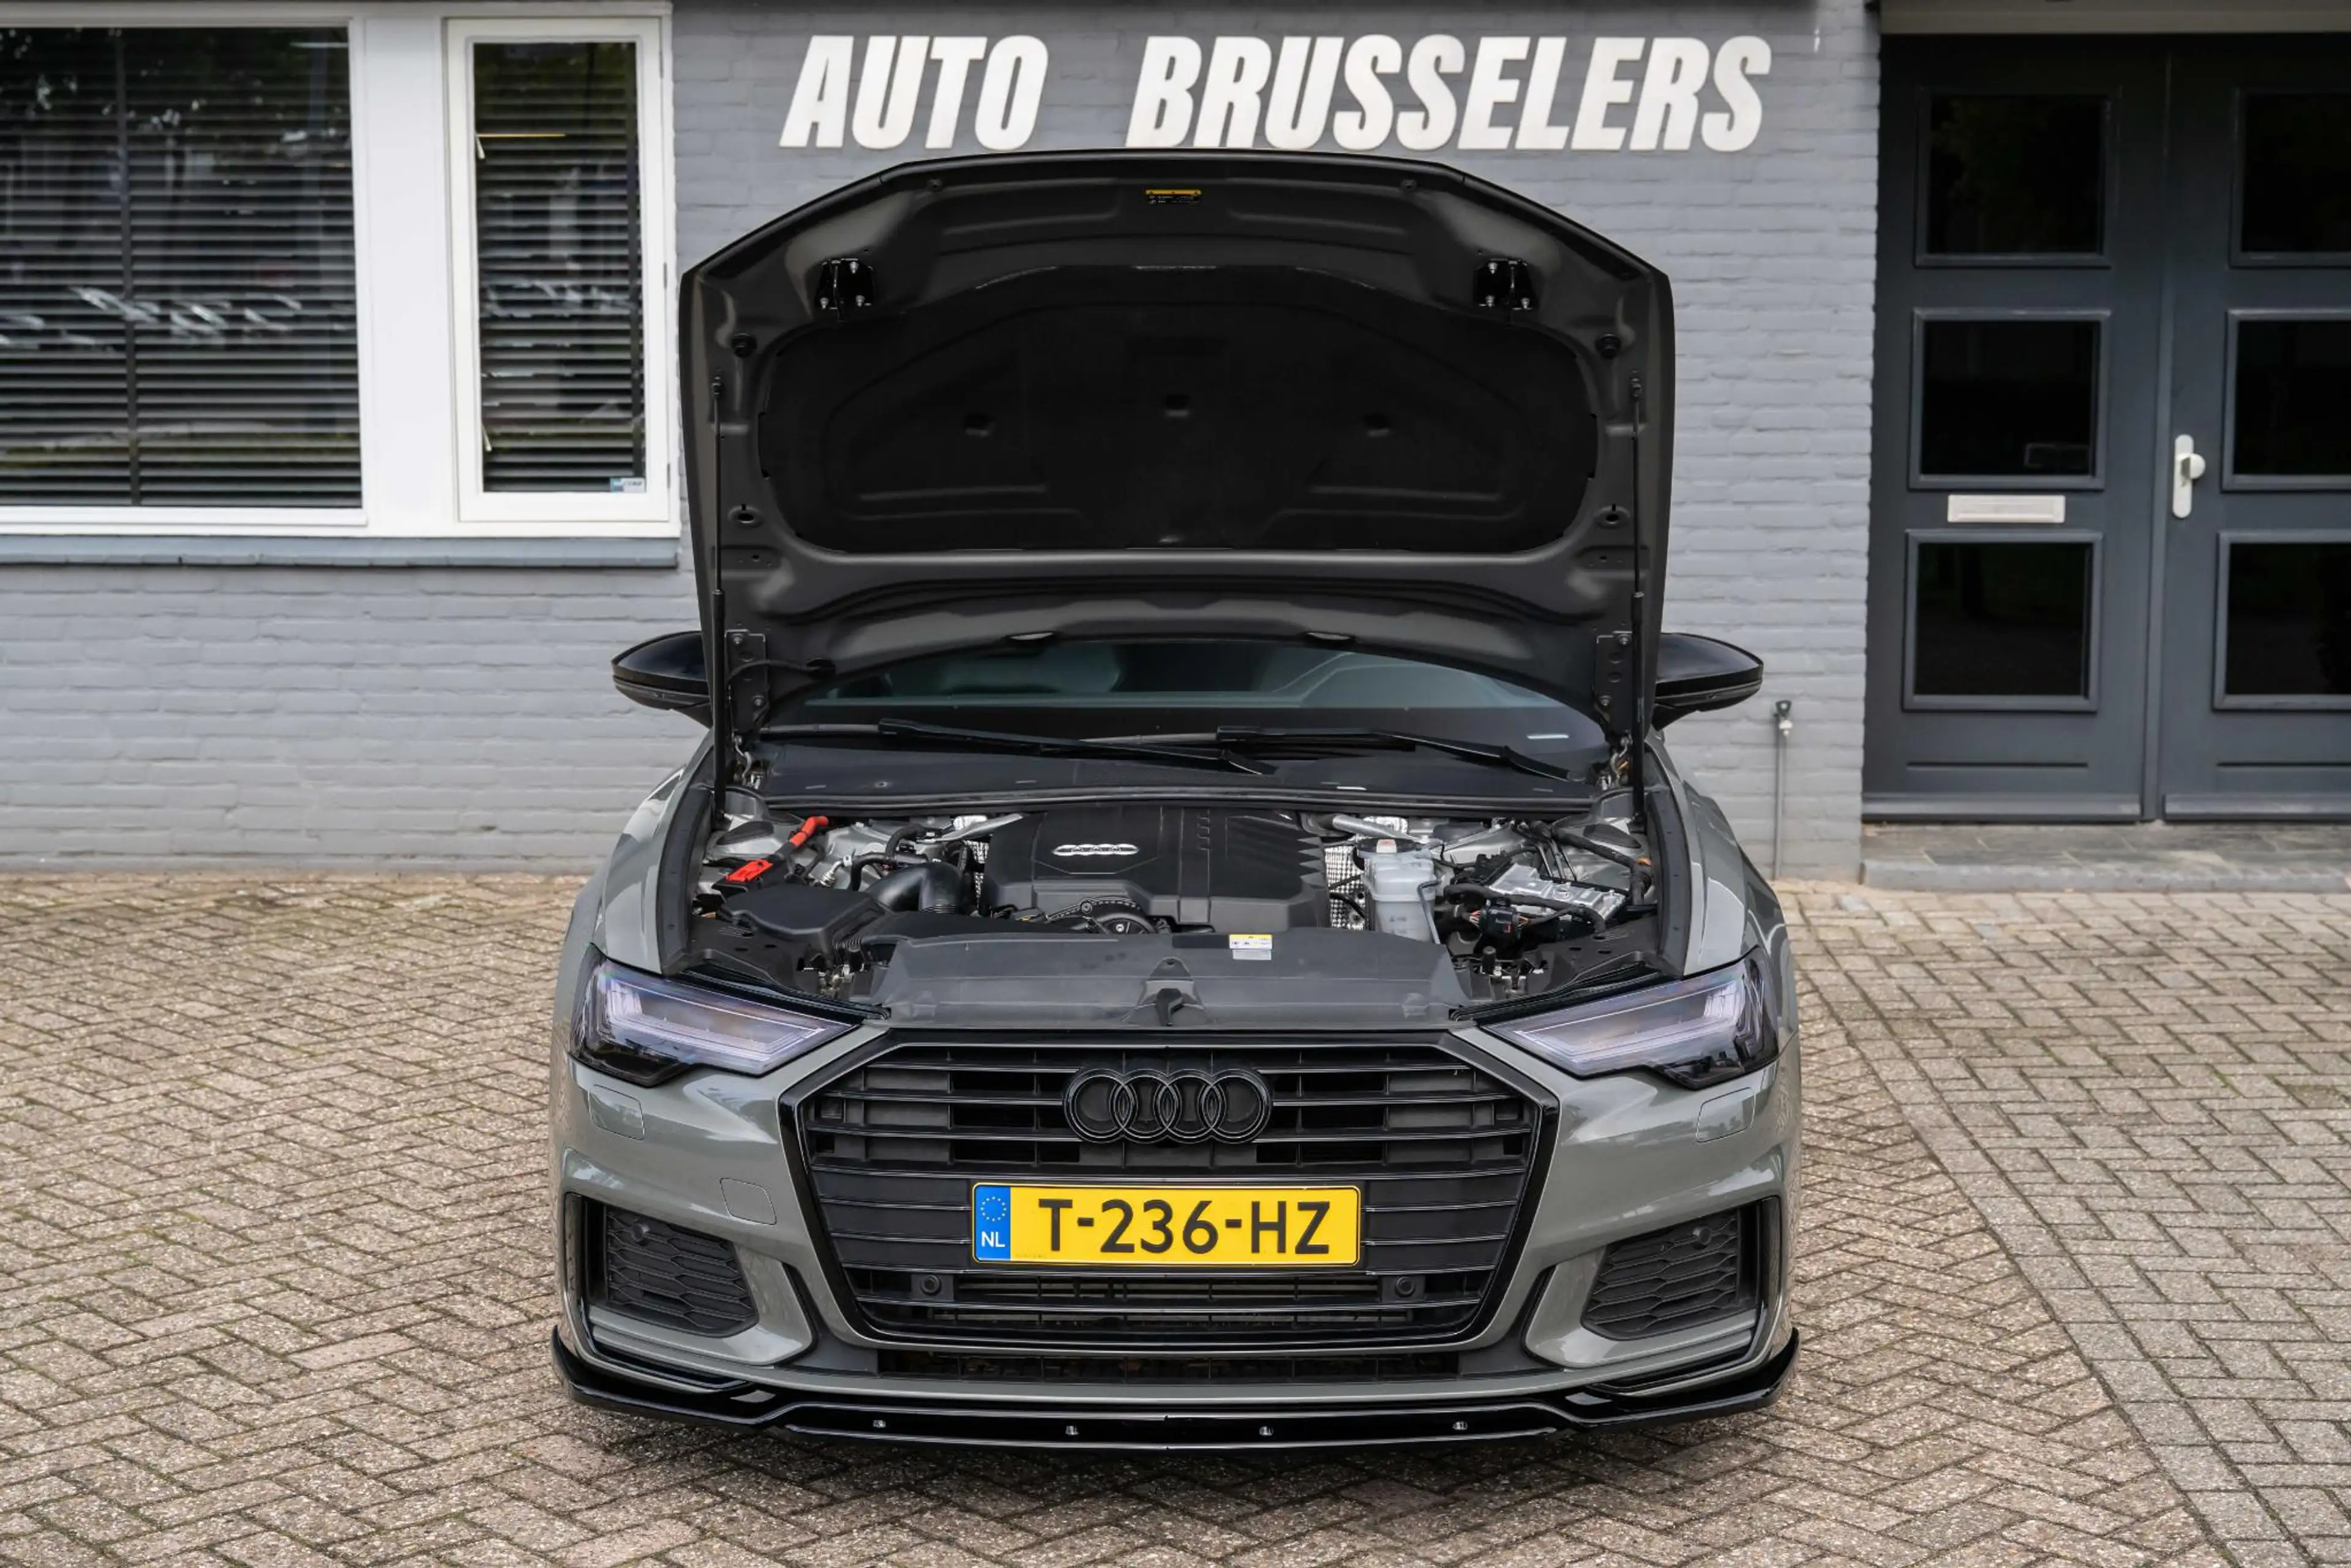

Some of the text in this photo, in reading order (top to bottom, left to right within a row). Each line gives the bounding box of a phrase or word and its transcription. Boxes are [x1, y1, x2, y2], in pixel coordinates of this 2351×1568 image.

[779, 34, 1772, 151] AUTO BRUSSELERS
[981, 1231, 1006, 1248] NL
[1038, 1198, 1330, 1255] T-236-HZ
